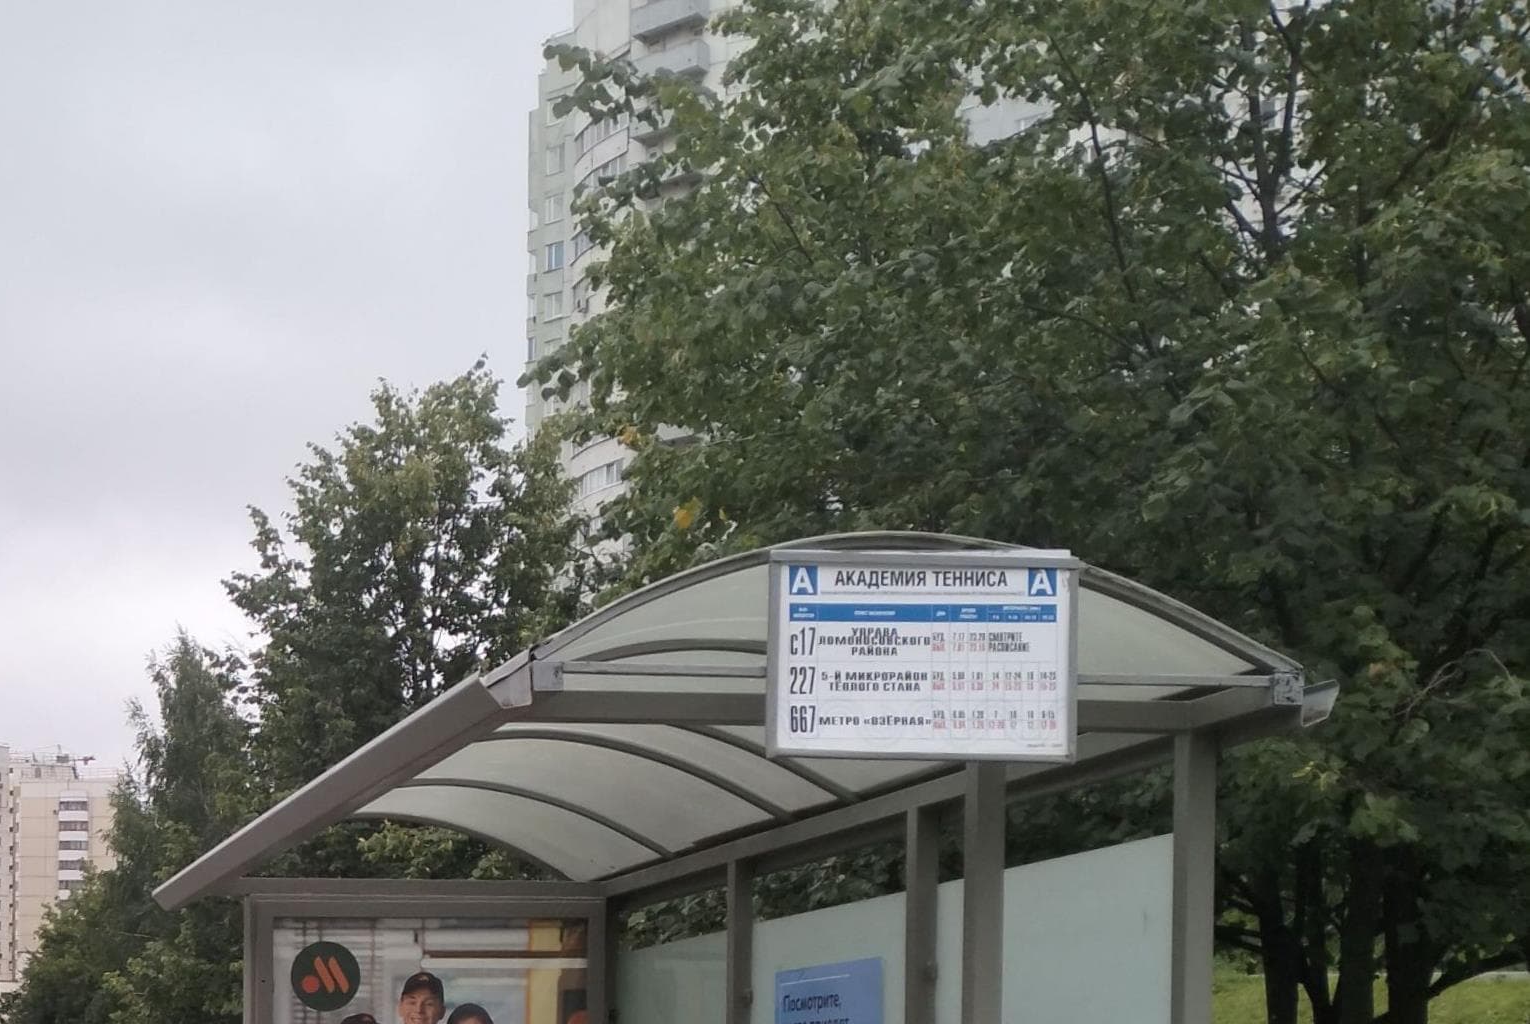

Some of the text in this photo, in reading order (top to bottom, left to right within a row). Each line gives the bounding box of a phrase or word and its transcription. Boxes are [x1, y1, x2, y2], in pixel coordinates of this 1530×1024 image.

[834, 570, 1008, 589] АКАДЕМИЯ ТЕННИСА
[851, 627, 898, 639] УПРАВА
[790, 627, 816, 656] с17
[851, 646, 898, 656] РАЙОНА
[790, 666, 816, 695] 227
[845, 671, 928, 681] МИКРОРАЙОН
[883, 682, 921, 692] СТАНА
[790, 705, 816, 733] 667
[819, 716, 860, 726] МЕТРО
[782, 994, 841, 1013] Посмотрите,
